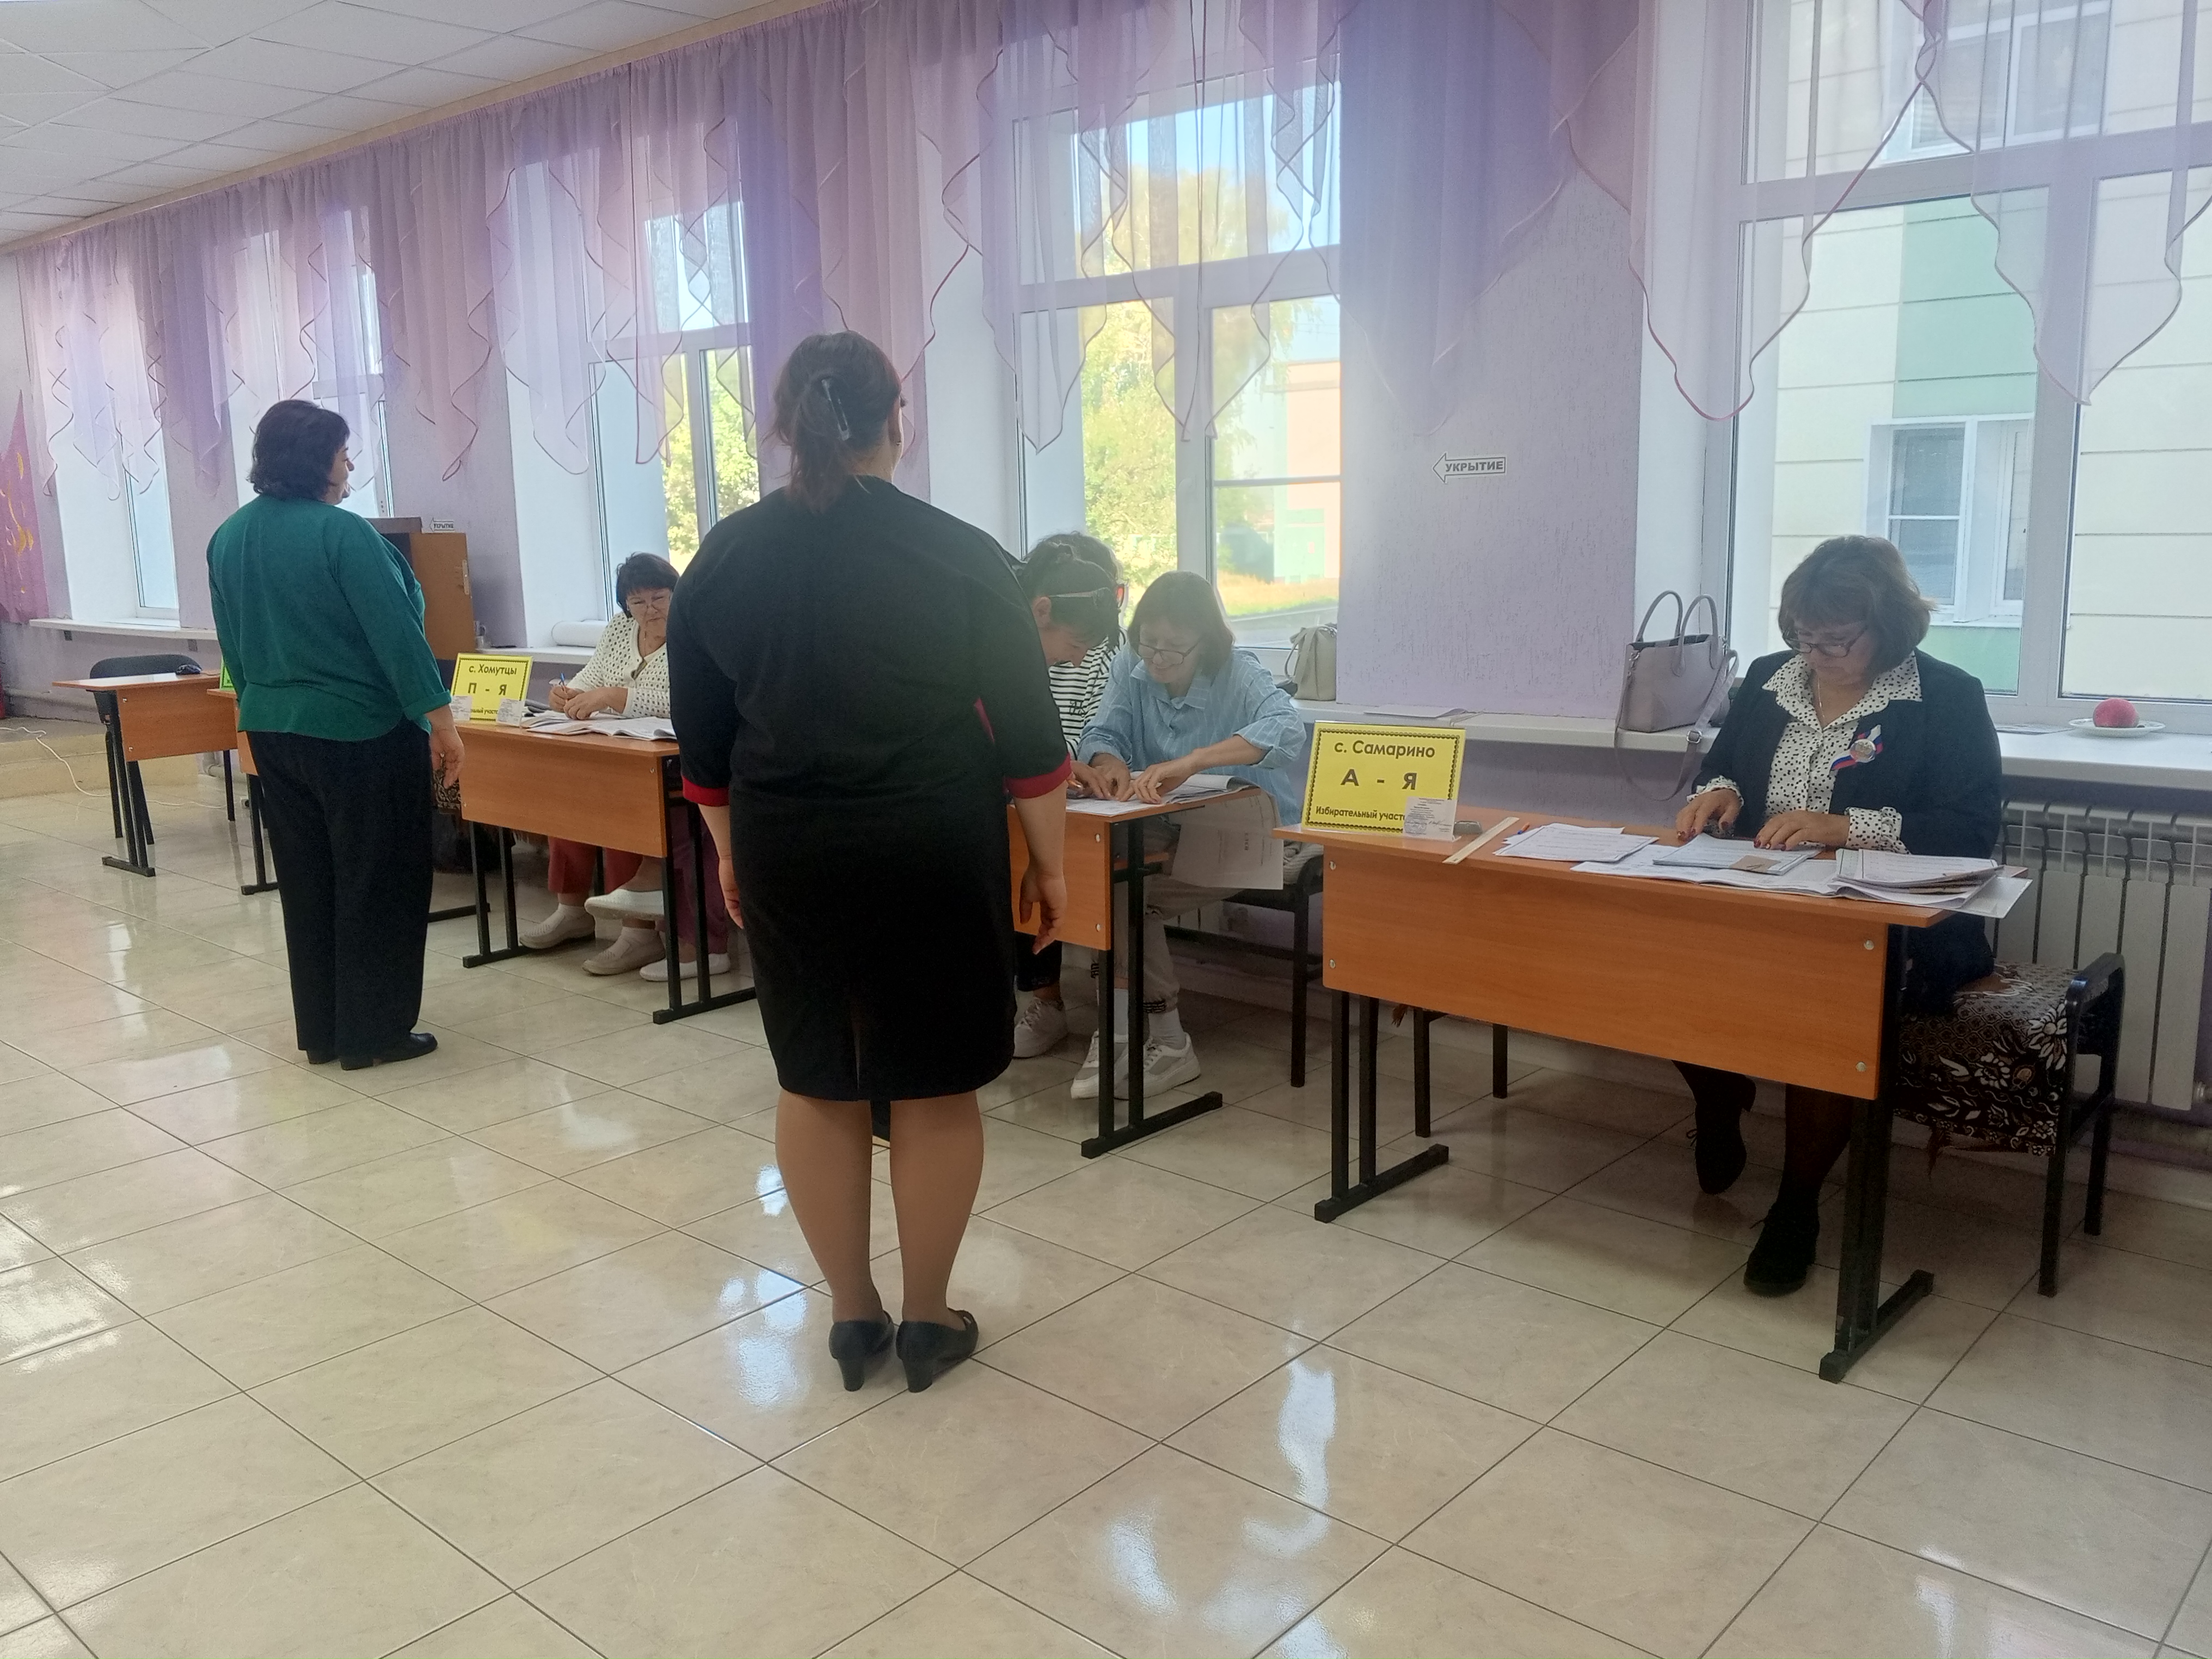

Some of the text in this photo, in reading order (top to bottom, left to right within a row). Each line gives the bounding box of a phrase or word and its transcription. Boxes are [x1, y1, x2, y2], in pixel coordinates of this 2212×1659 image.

[1445, 460, 1503, 472] УКРЫТИЕ
[478, 663, 517, 676] Хомутцы
[468, 682, 477, 694] П
[498, 684, 507, 696] Я
[1334, 740, 1435, 759] с. Самарино
[1340, 769, 1360, 787] А
[1402, 772, 1417, 790] Я
[1316, 806, 1377, 819] Избирательный
